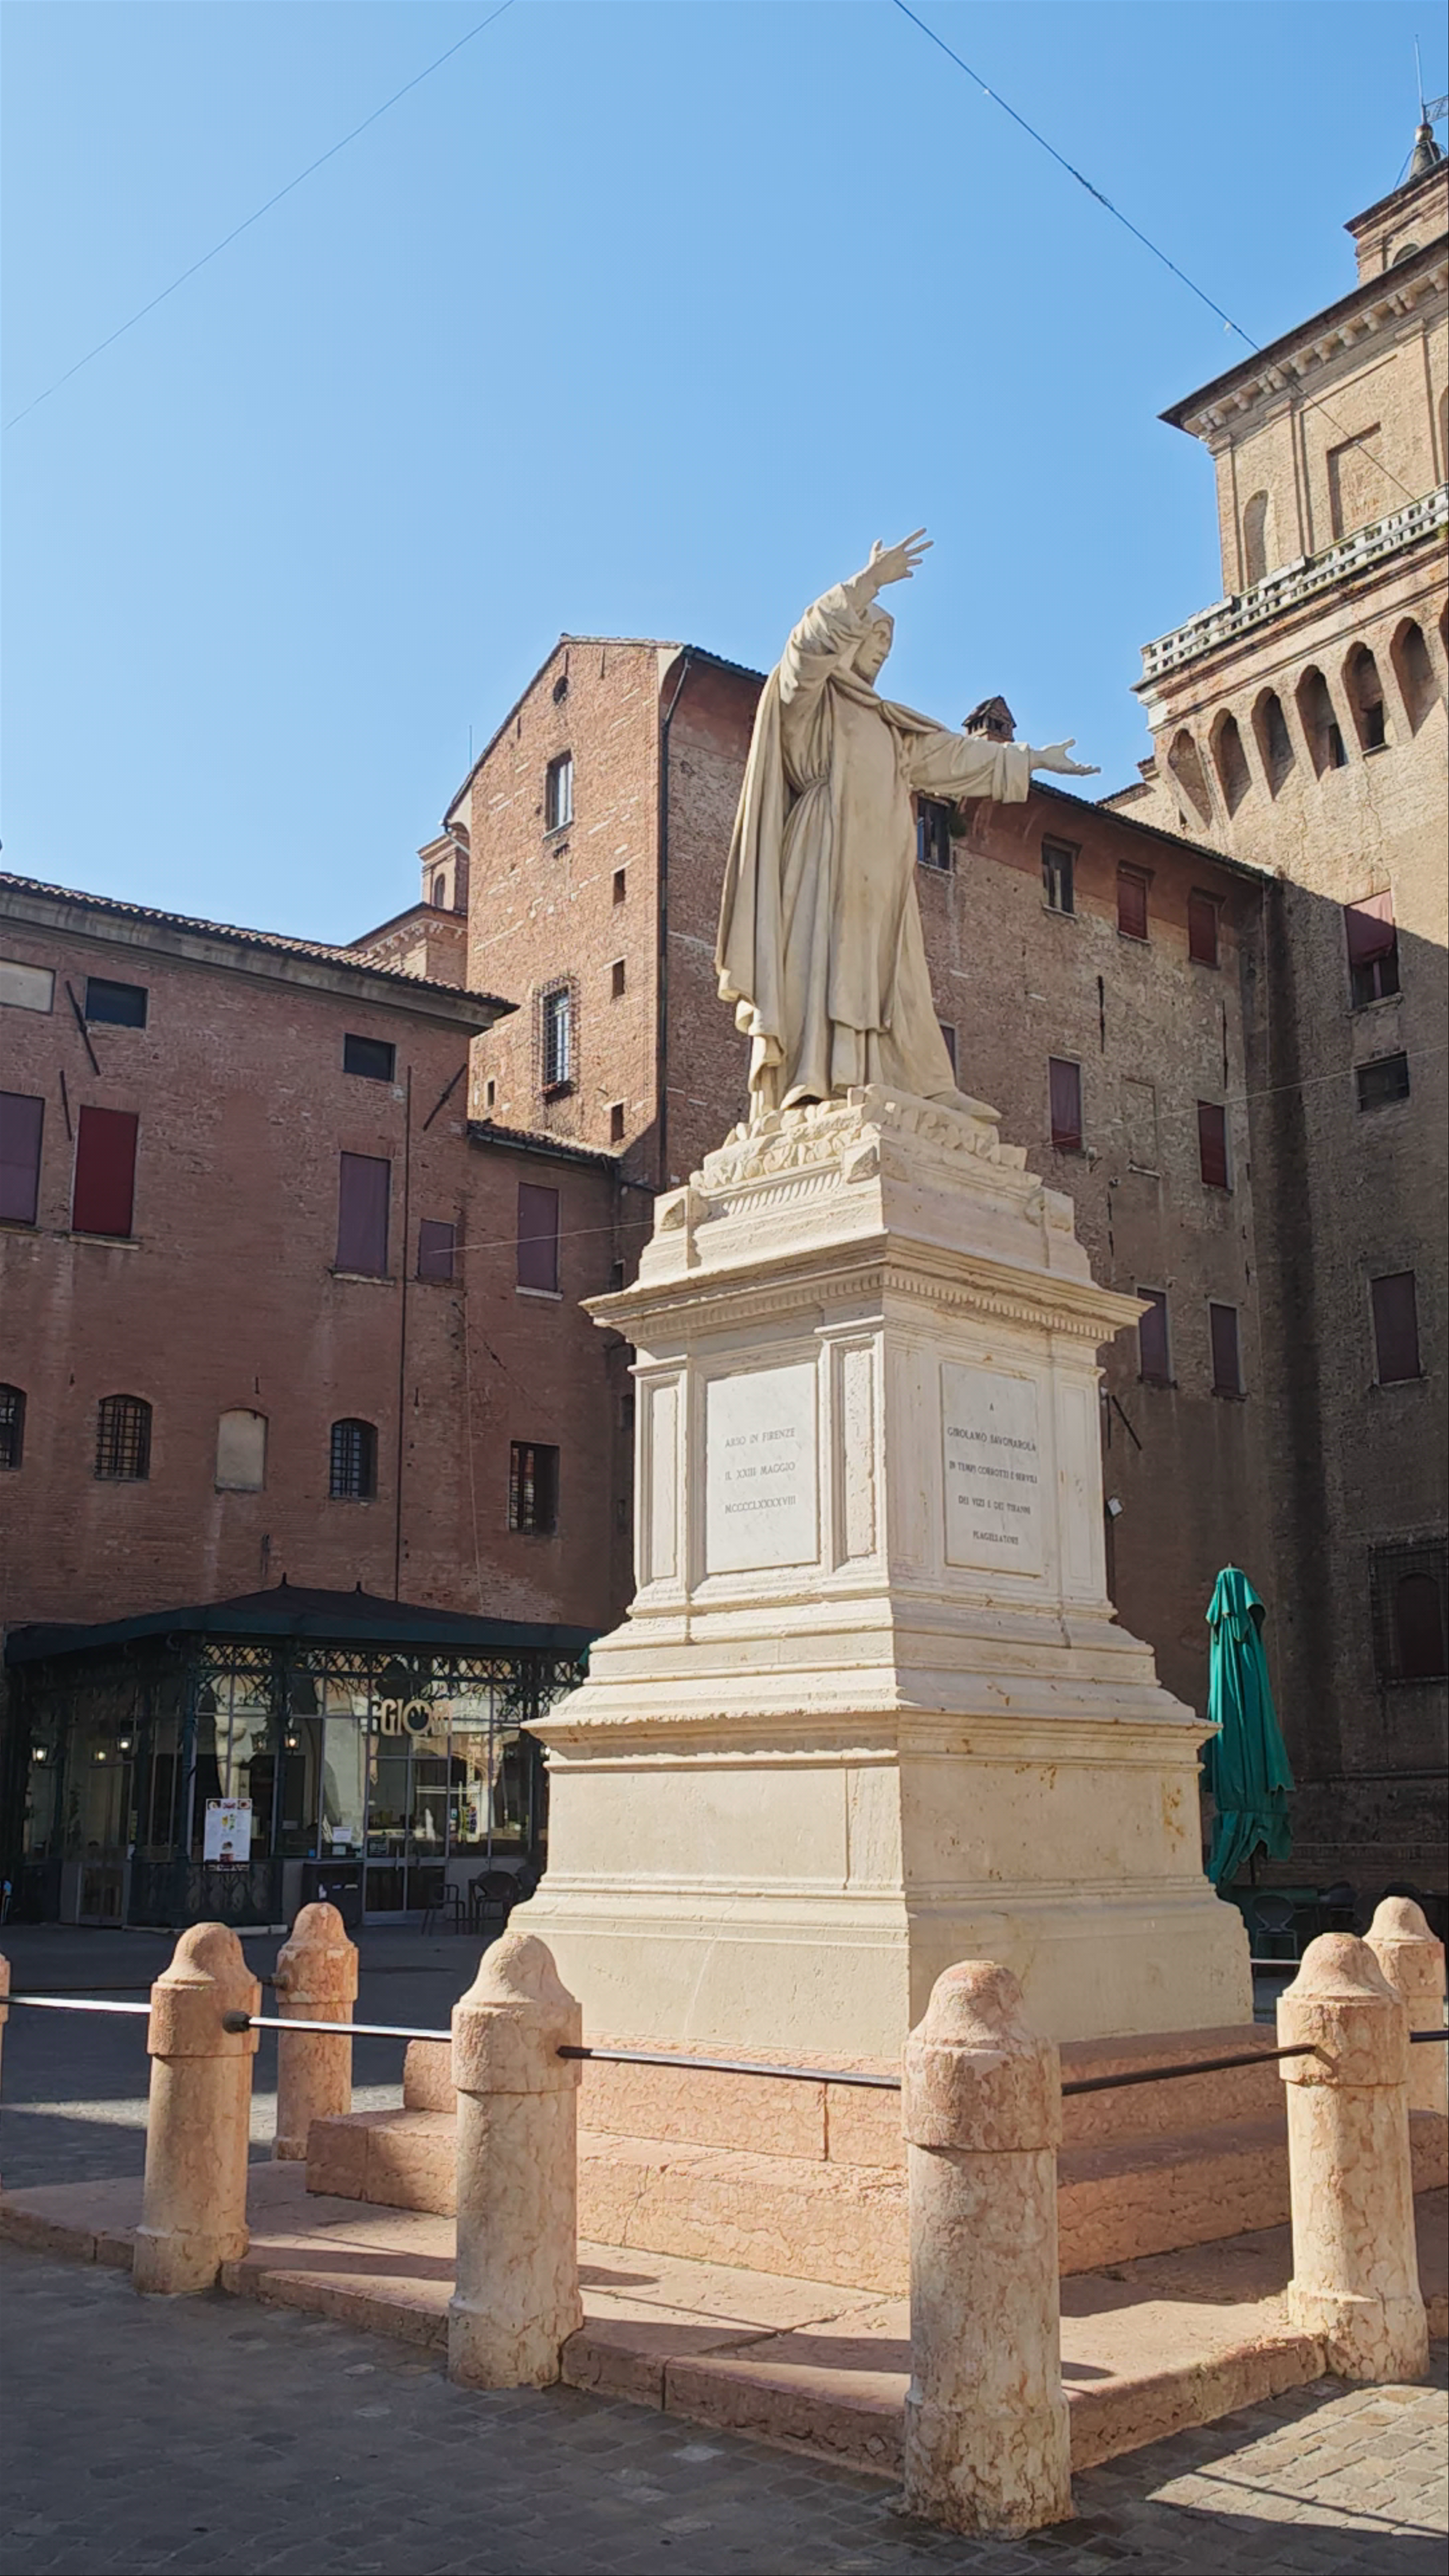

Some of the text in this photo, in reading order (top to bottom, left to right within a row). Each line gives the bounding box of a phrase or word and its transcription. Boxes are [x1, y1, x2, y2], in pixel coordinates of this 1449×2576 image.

[989, 1403, 994, 1411] A
[725, 1436, 746, 1448] ARSO
[762, 1428, 795, 1443] FIRENZE
[948, 1427, 1036, 1452] GIROLAMO SAVONAROLA
[725, 1462, 795, 1480] IL XXIII MAGGIO
